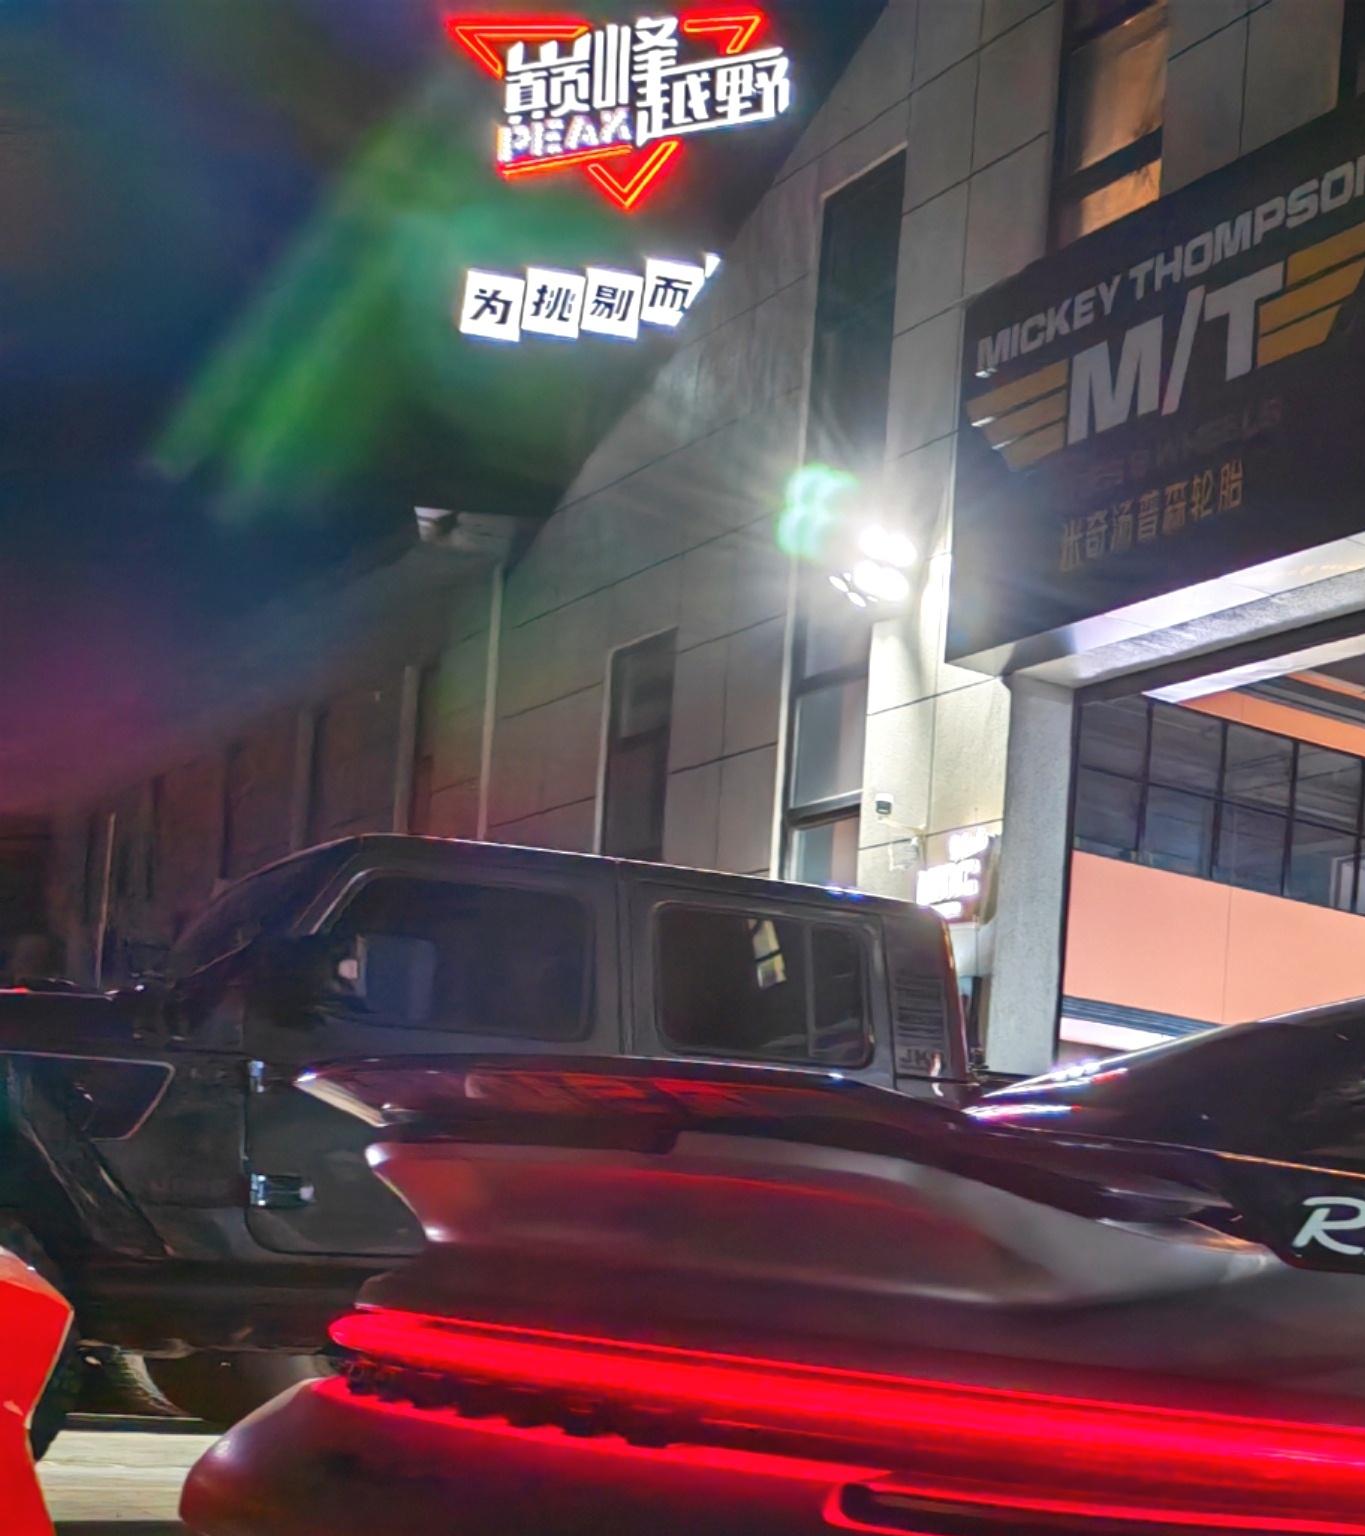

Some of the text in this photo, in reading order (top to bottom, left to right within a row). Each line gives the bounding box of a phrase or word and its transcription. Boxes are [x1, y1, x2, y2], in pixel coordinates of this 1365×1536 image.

[504, 16, 790, 146] 巅峰越野
[498, 107, 633, 162] PEAK
[471, 276, 693, 325] 为挑剔而
[975, 273, 1122, 371] MICKEY
[1066, 261, 1285, 446] M/T
